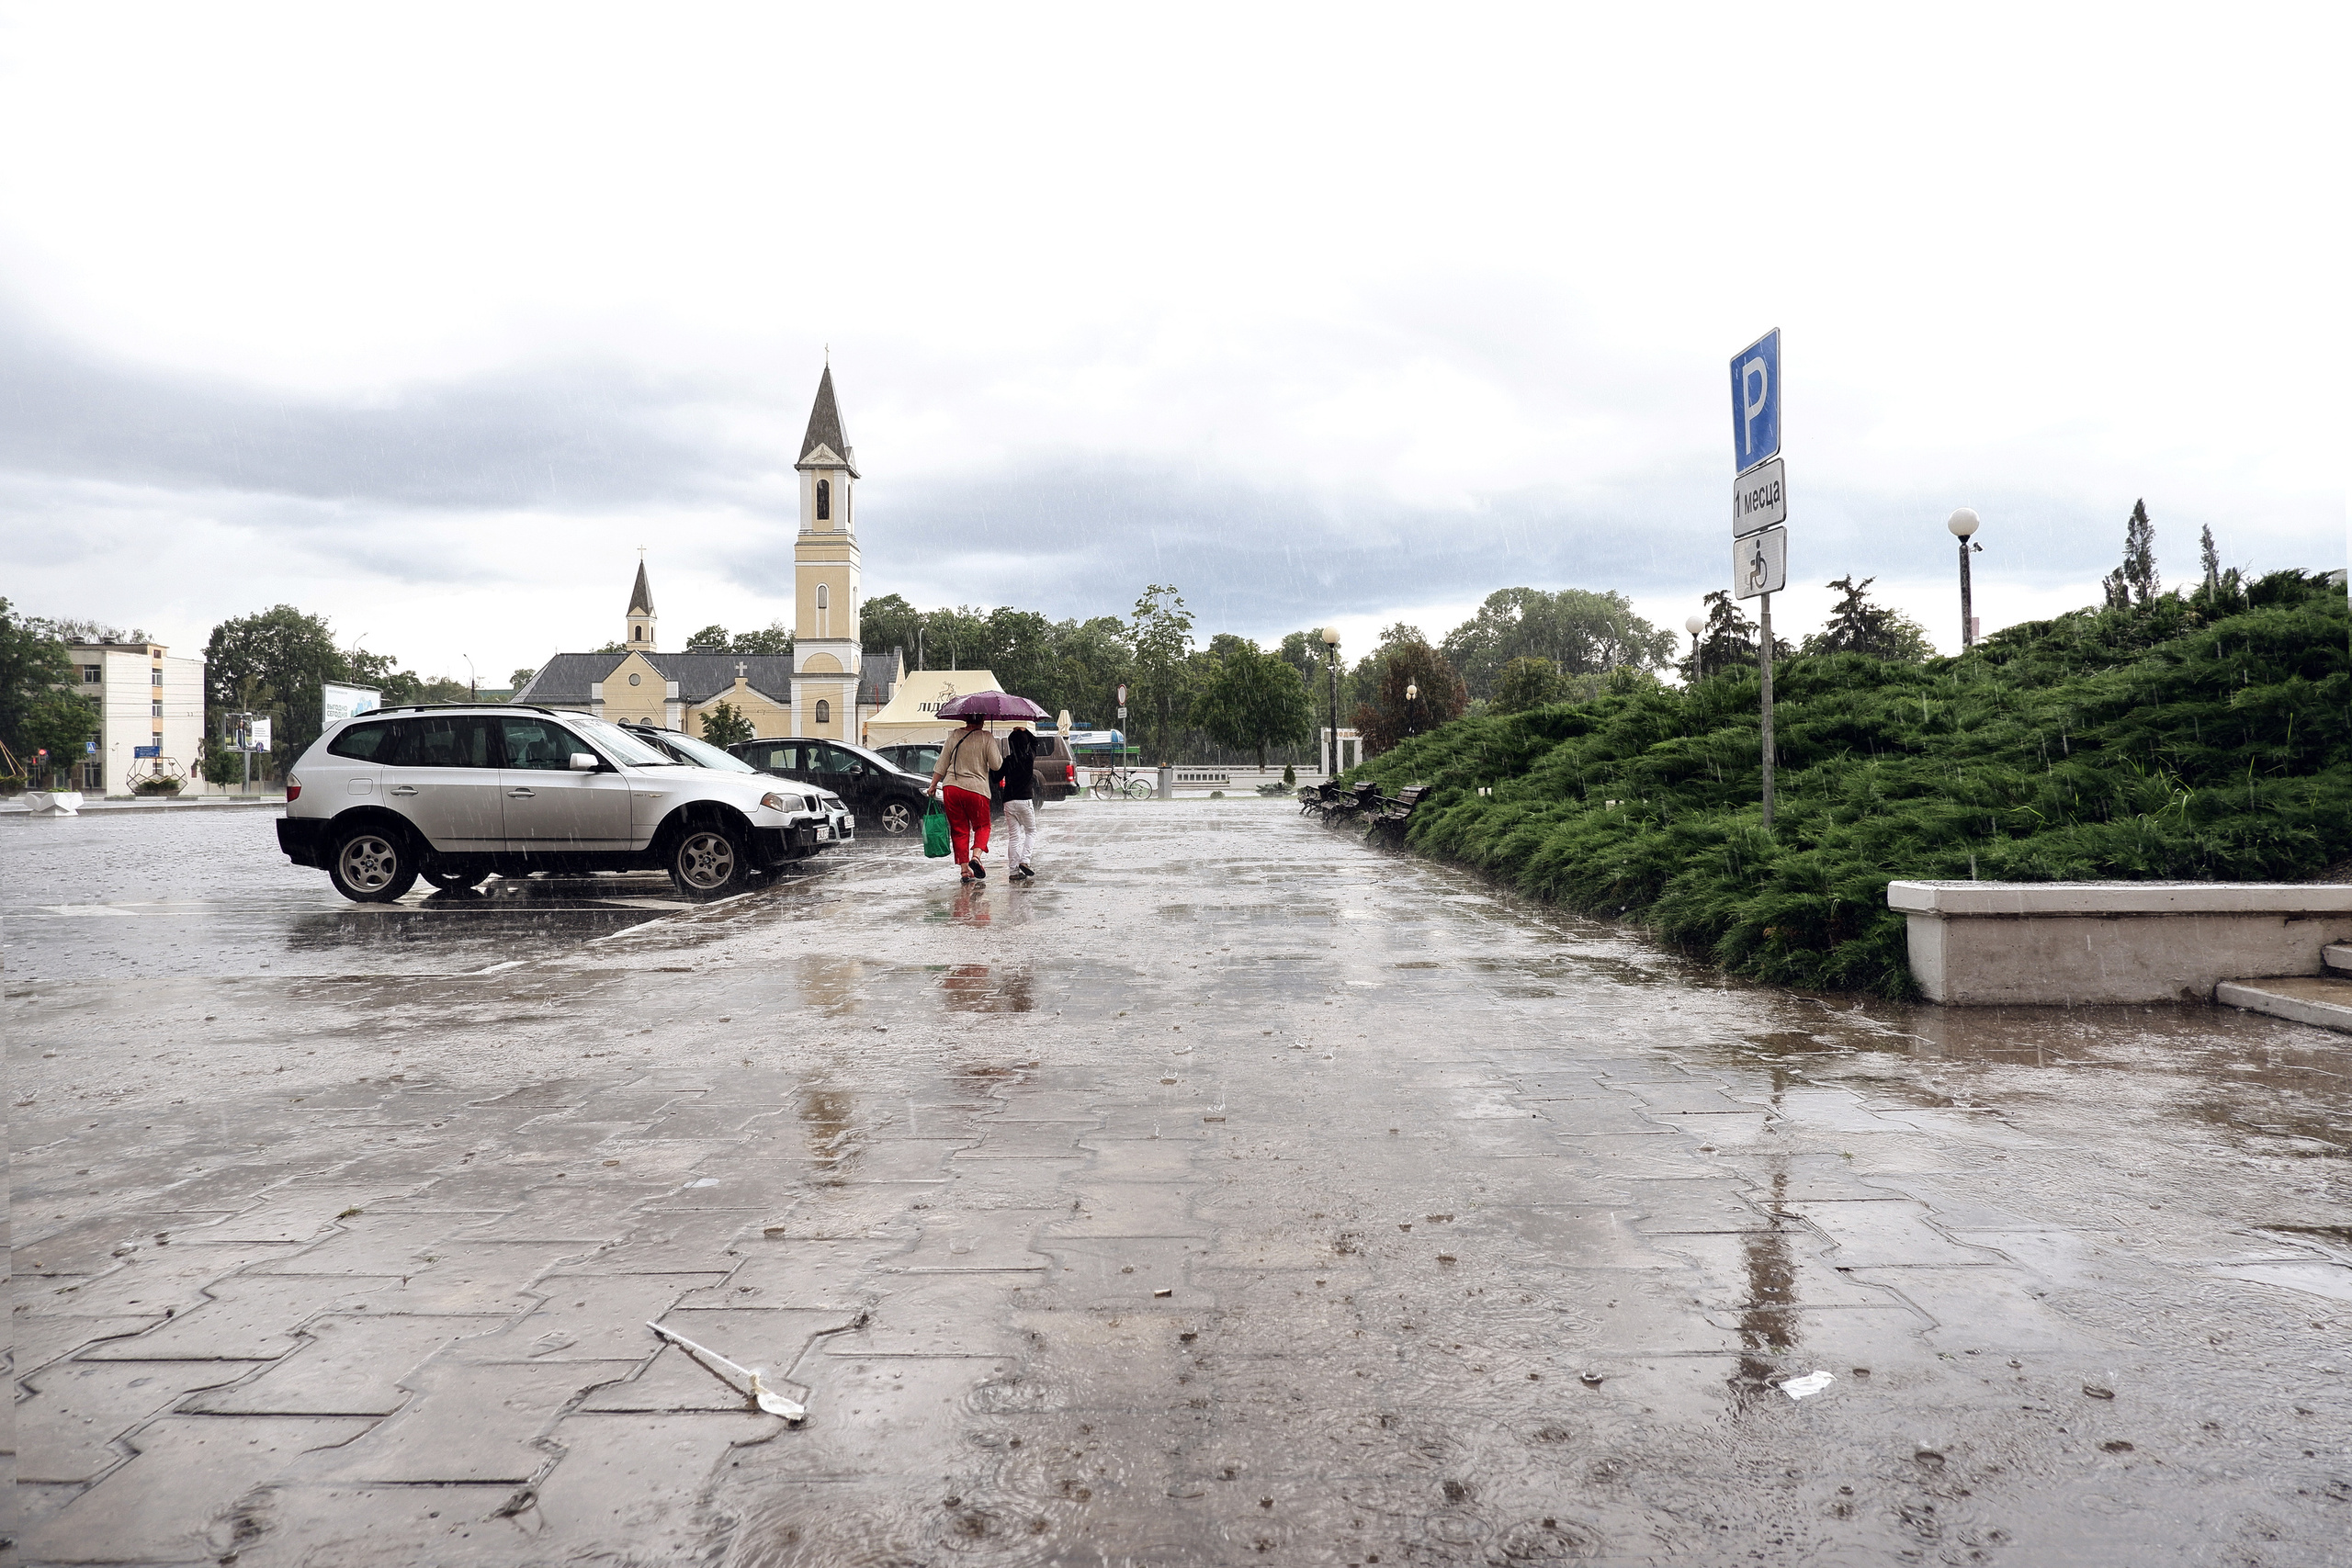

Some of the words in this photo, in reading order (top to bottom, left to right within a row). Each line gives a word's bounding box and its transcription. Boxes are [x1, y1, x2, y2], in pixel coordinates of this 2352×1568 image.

[1742, 356, 1767, 455] P
[1736, 490, 1740, 518] 1
[1744, 480, 1780, 515] месца
